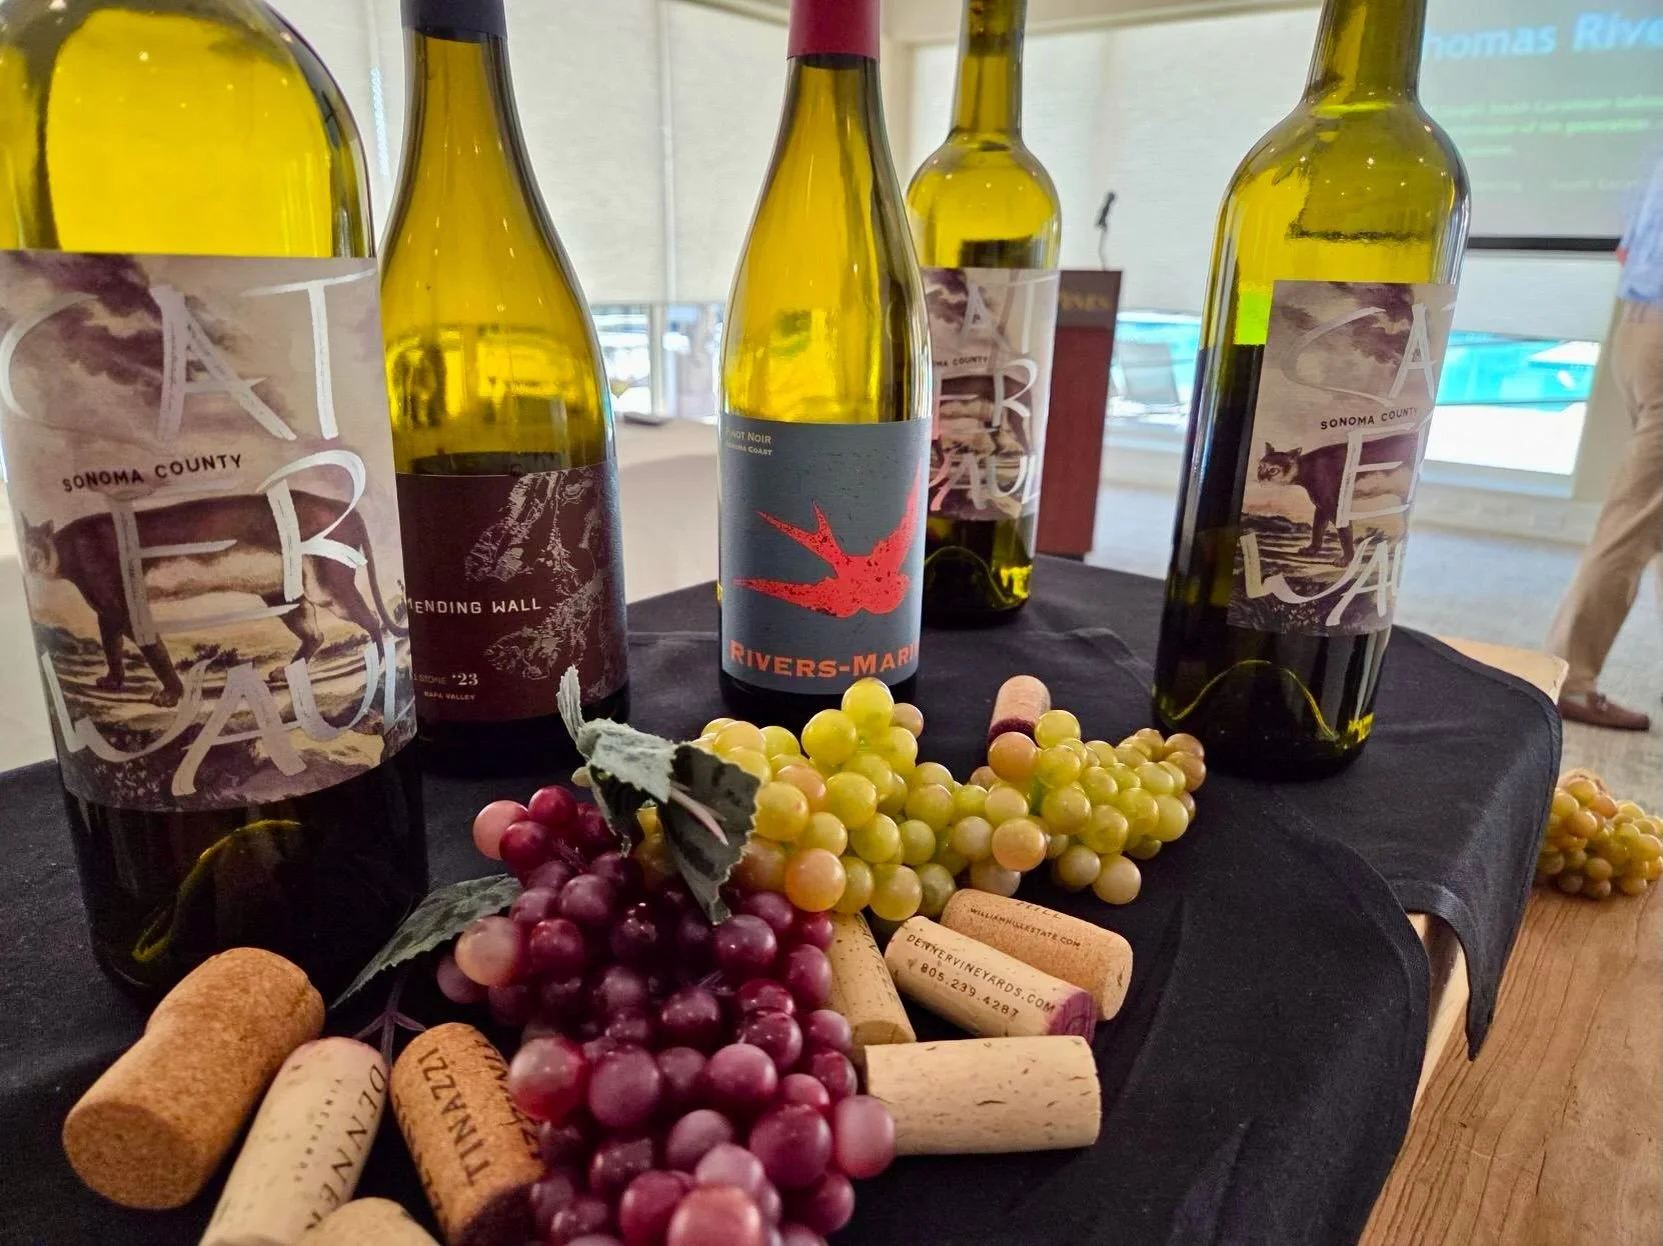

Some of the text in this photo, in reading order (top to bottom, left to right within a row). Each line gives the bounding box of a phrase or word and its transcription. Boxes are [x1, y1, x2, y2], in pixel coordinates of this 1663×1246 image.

[1425, 25, 1557, 61] homas
[926, 274, 1058, 357] AT
[1, 268, 376, 441] CAT
[952, 355, 988, 366] COUNTY
[1280, 303, 1456, 408] CA
[747, 431, 772, 445] NOIR
[1320, 414, 1375, 430] SONOMA
[62, 454, 242, 493] SONOMA COUNTY
[748, 446, 773, 456] COAST
[928, 452, 1041, 512] AUL
[108, 449, 368, 646] ER
[491, 597, 542, 613] WALL
[445, 692, 476, 701] VALLEY
[907, 932, 1056, 1014] DENNERVINEYARDS.COM
[919, 961, 1020, 1019] 805.239.4287
[418, 1047, 492, 1187] TINAZZI
